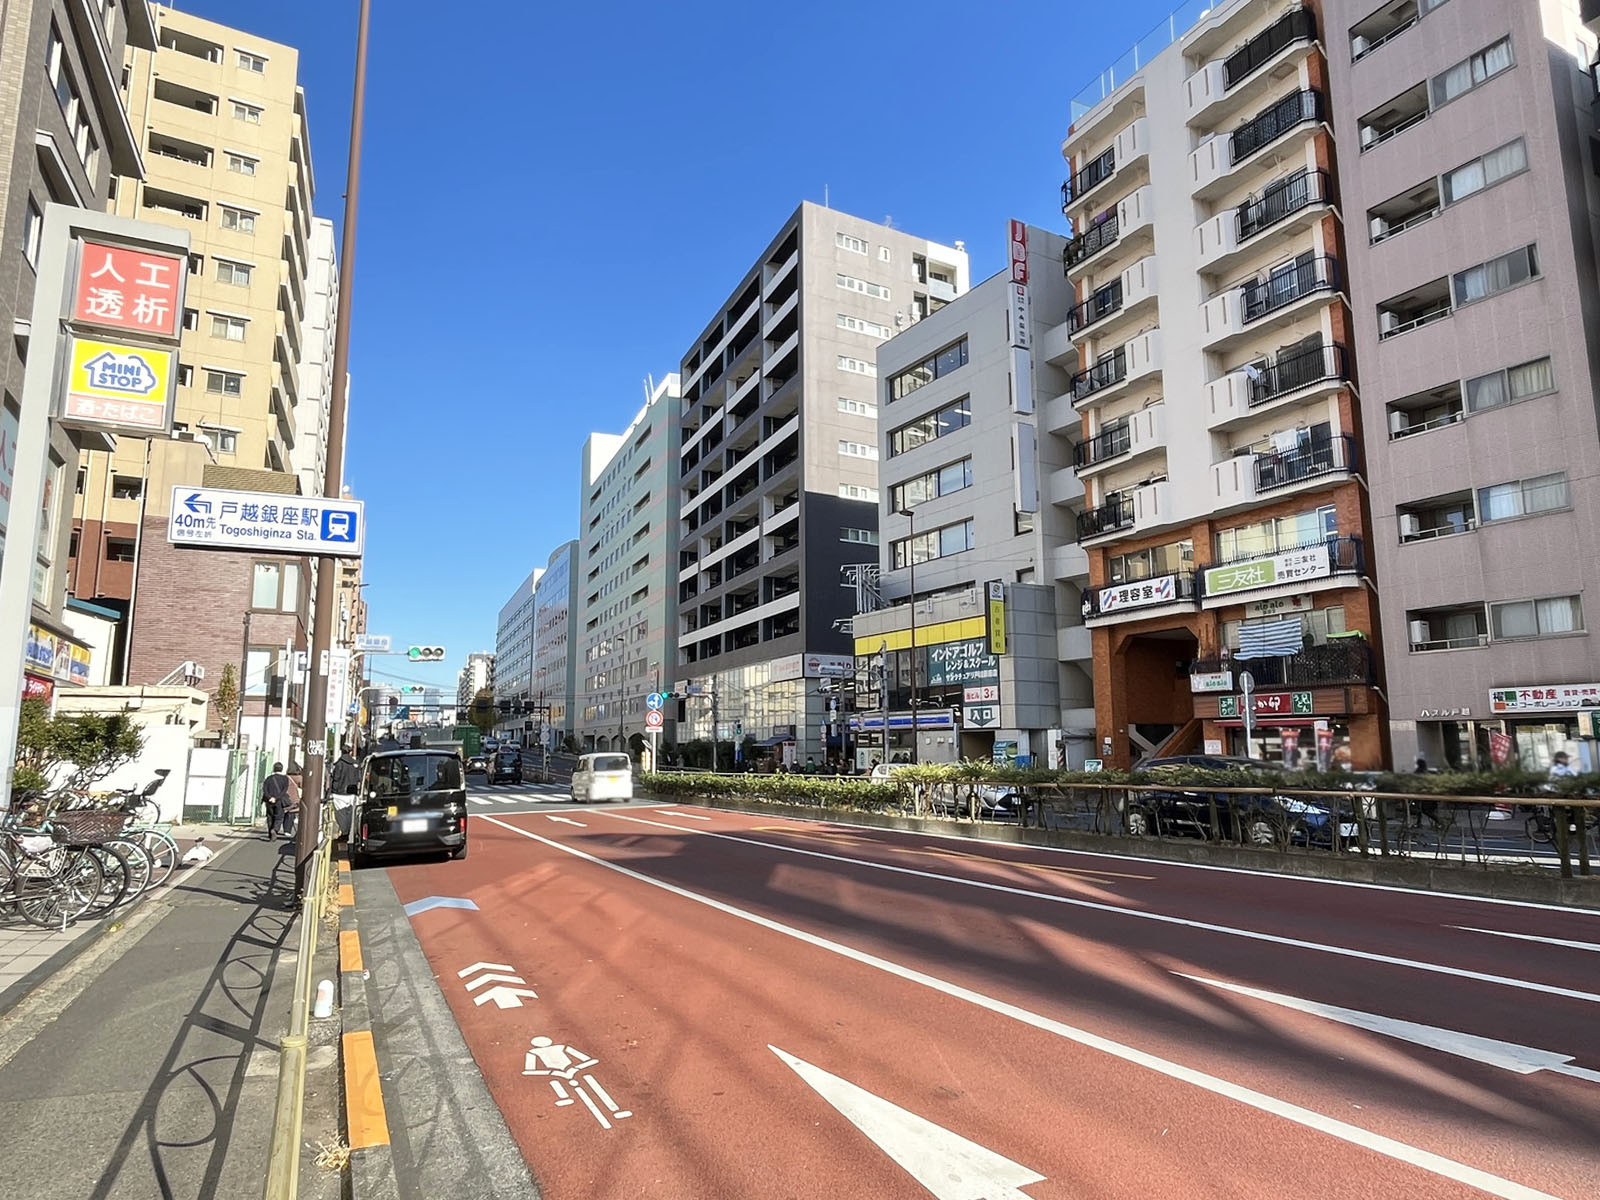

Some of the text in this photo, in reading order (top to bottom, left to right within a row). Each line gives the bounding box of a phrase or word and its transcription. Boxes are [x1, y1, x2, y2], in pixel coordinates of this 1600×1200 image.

[89, 253, 171, 289] 人工
[85, 287, 170, 326] 透析
[102, 361, 141, 376] MINI
[99, 373, 142, 387] STOP
[175, 513, 217, 530] 40m先
[219, 501, 319, 527] 戸越銀座駅
[219, 524, 317, 541] Togoshiginza Sta.
[1217, 566, 1266, 590] 三友社
[1277, 565, 1325, 580] 売買センター
[1118, 585, 1154, 603] 理容室
[931, 643, 984, 662] インドアゴルフ
[1519, 689, 1558, 700] 不動産
[1520, 700, 1580, 708] コーポレーション
[972, 709, 991, 721] 入口
